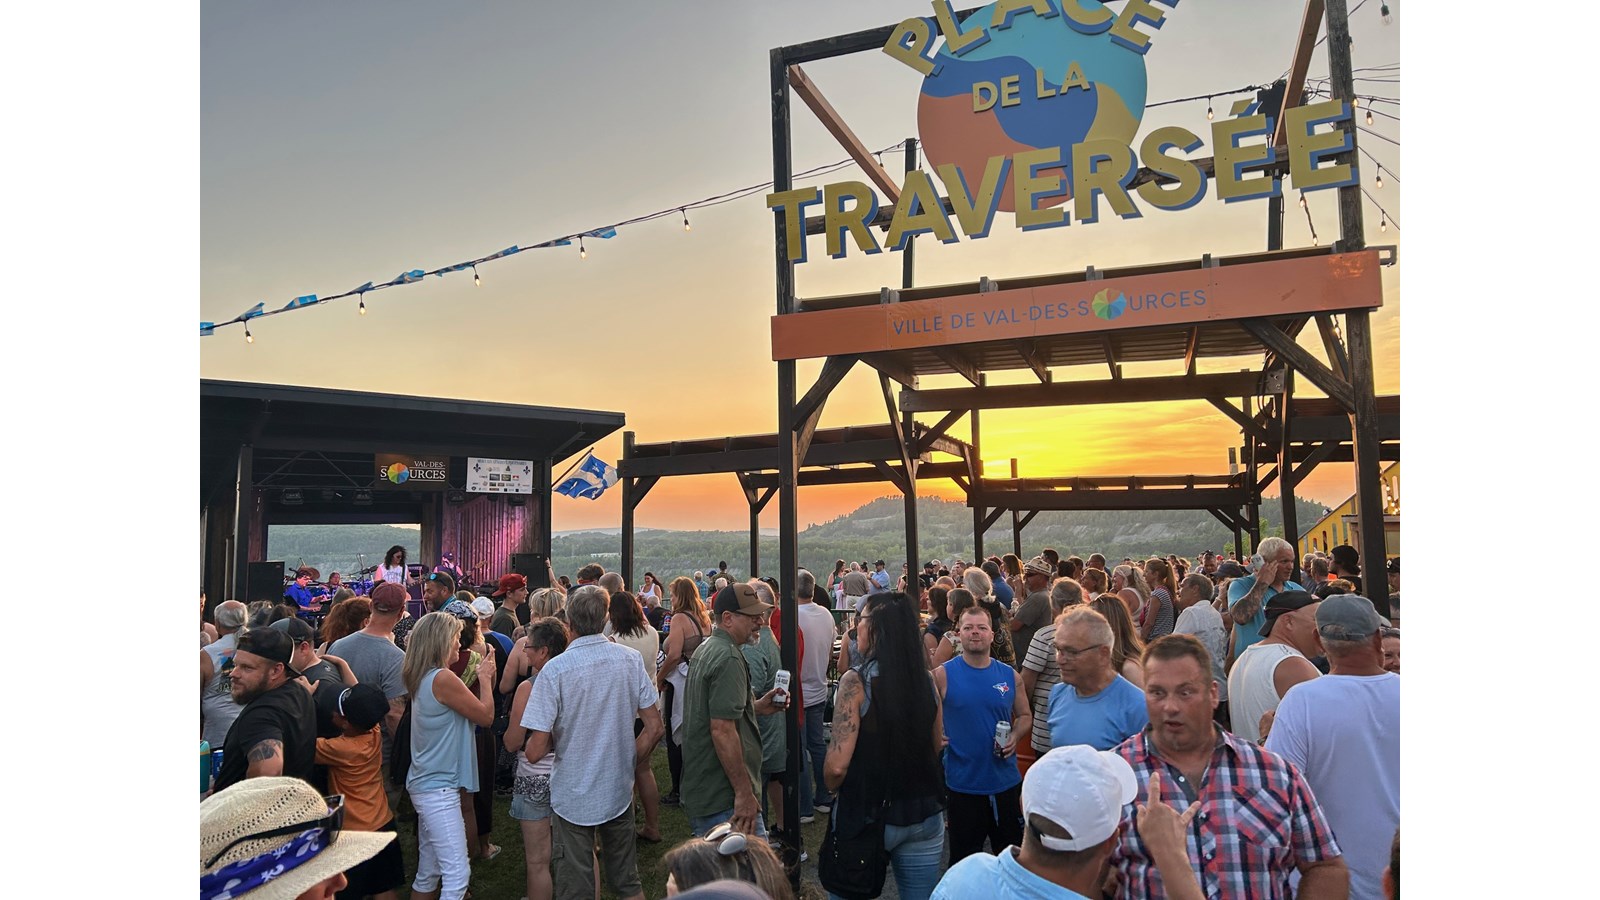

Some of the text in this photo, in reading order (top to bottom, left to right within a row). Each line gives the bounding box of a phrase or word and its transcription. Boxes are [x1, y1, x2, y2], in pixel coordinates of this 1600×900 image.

[972, 61, 1092, 113] DE LA
[766, 98, 1361, 264] TRAVERSÉE
[893, 315, 943, 335] VILLE
[951, 312, 976, 329] DE
[414, 460, 446, 468] VAL-DES-
